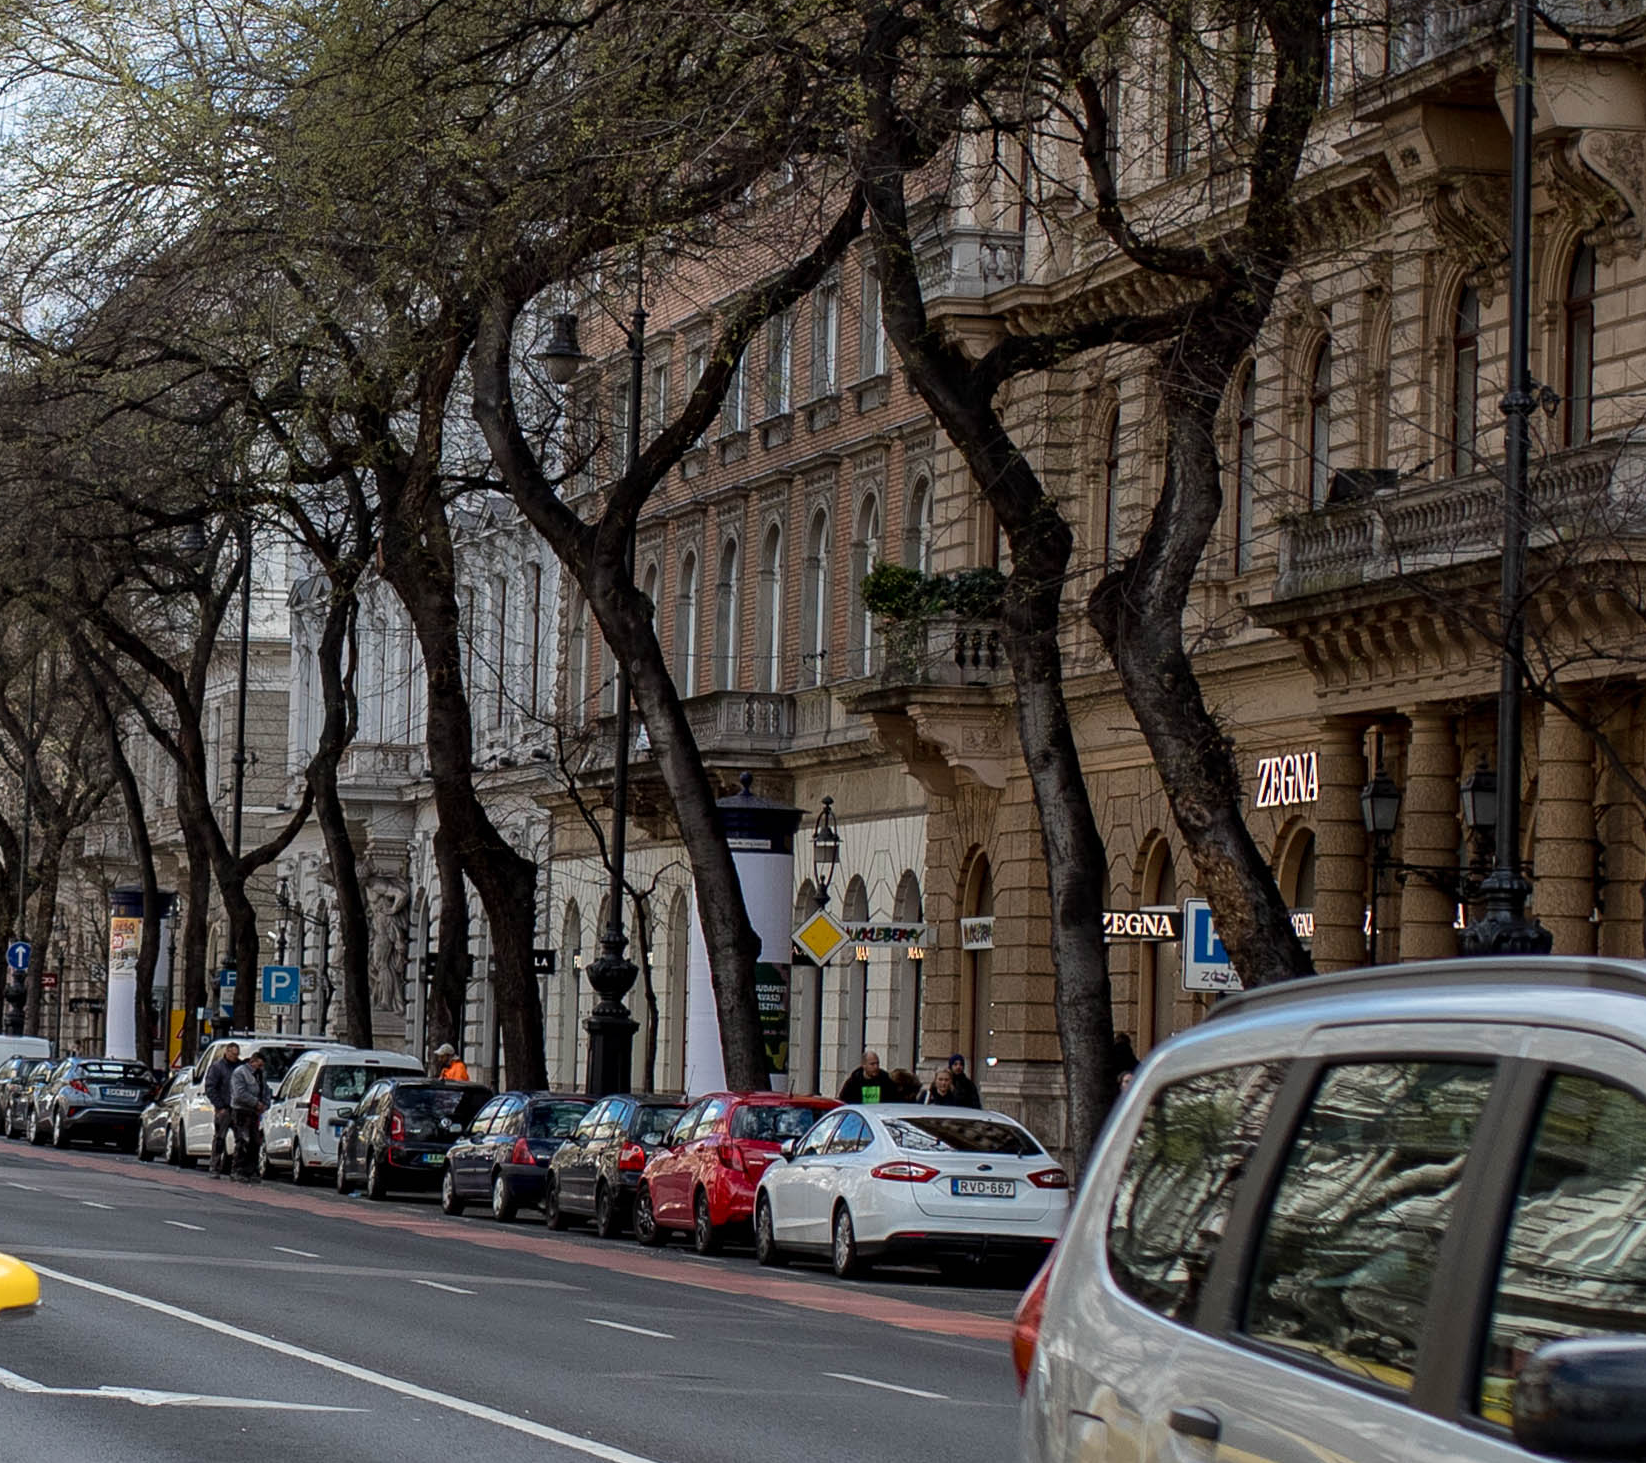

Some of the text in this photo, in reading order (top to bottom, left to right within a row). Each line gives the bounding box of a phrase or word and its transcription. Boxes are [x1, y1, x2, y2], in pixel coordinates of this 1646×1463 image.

[1257, 751, 1320, 808] ZEGNA
[845, 926, 925, 945] UCKLEBERRY
[1103, 913, 1175, 937] ZEGNA
[271, 971, 291, 999] P
[960, 1180, 1012, 1194] RVD-667
